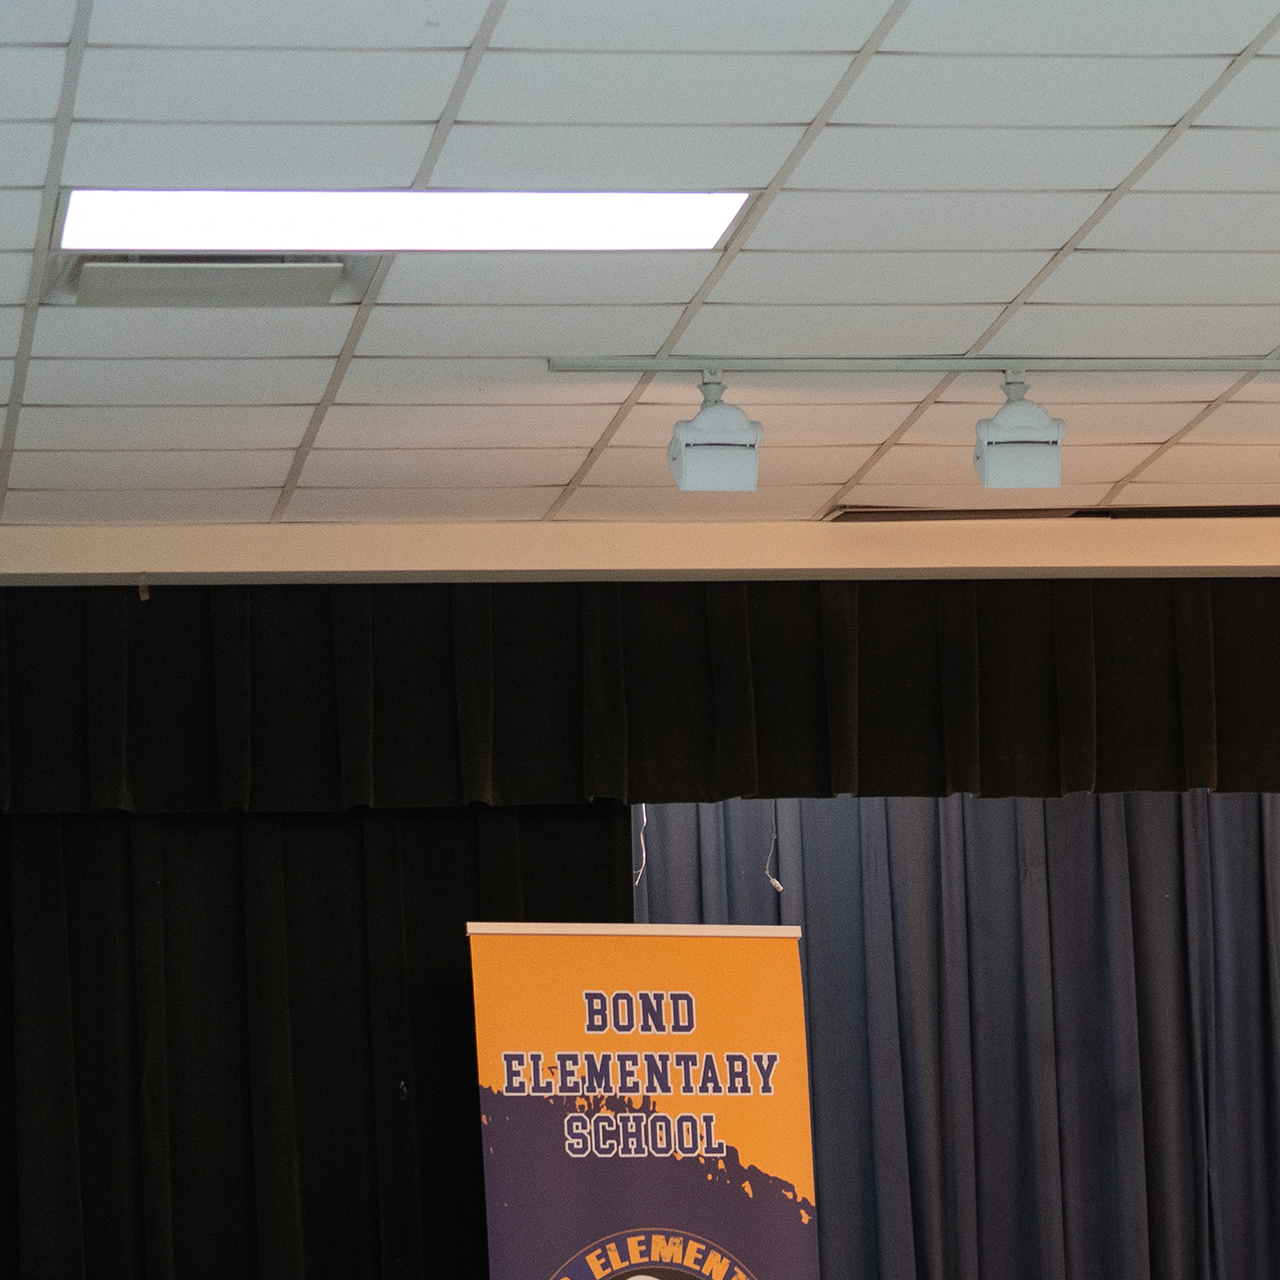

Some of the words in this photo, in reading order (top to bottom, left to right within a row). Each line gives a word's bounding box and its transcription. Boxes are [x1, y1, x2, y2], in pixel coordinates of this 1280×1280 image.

[583, 990, 696, 1034] BOND
[502, 1051, 779, 1096] ELEMENTARY
[564, 1113, 726, 1157] SCHOOL
